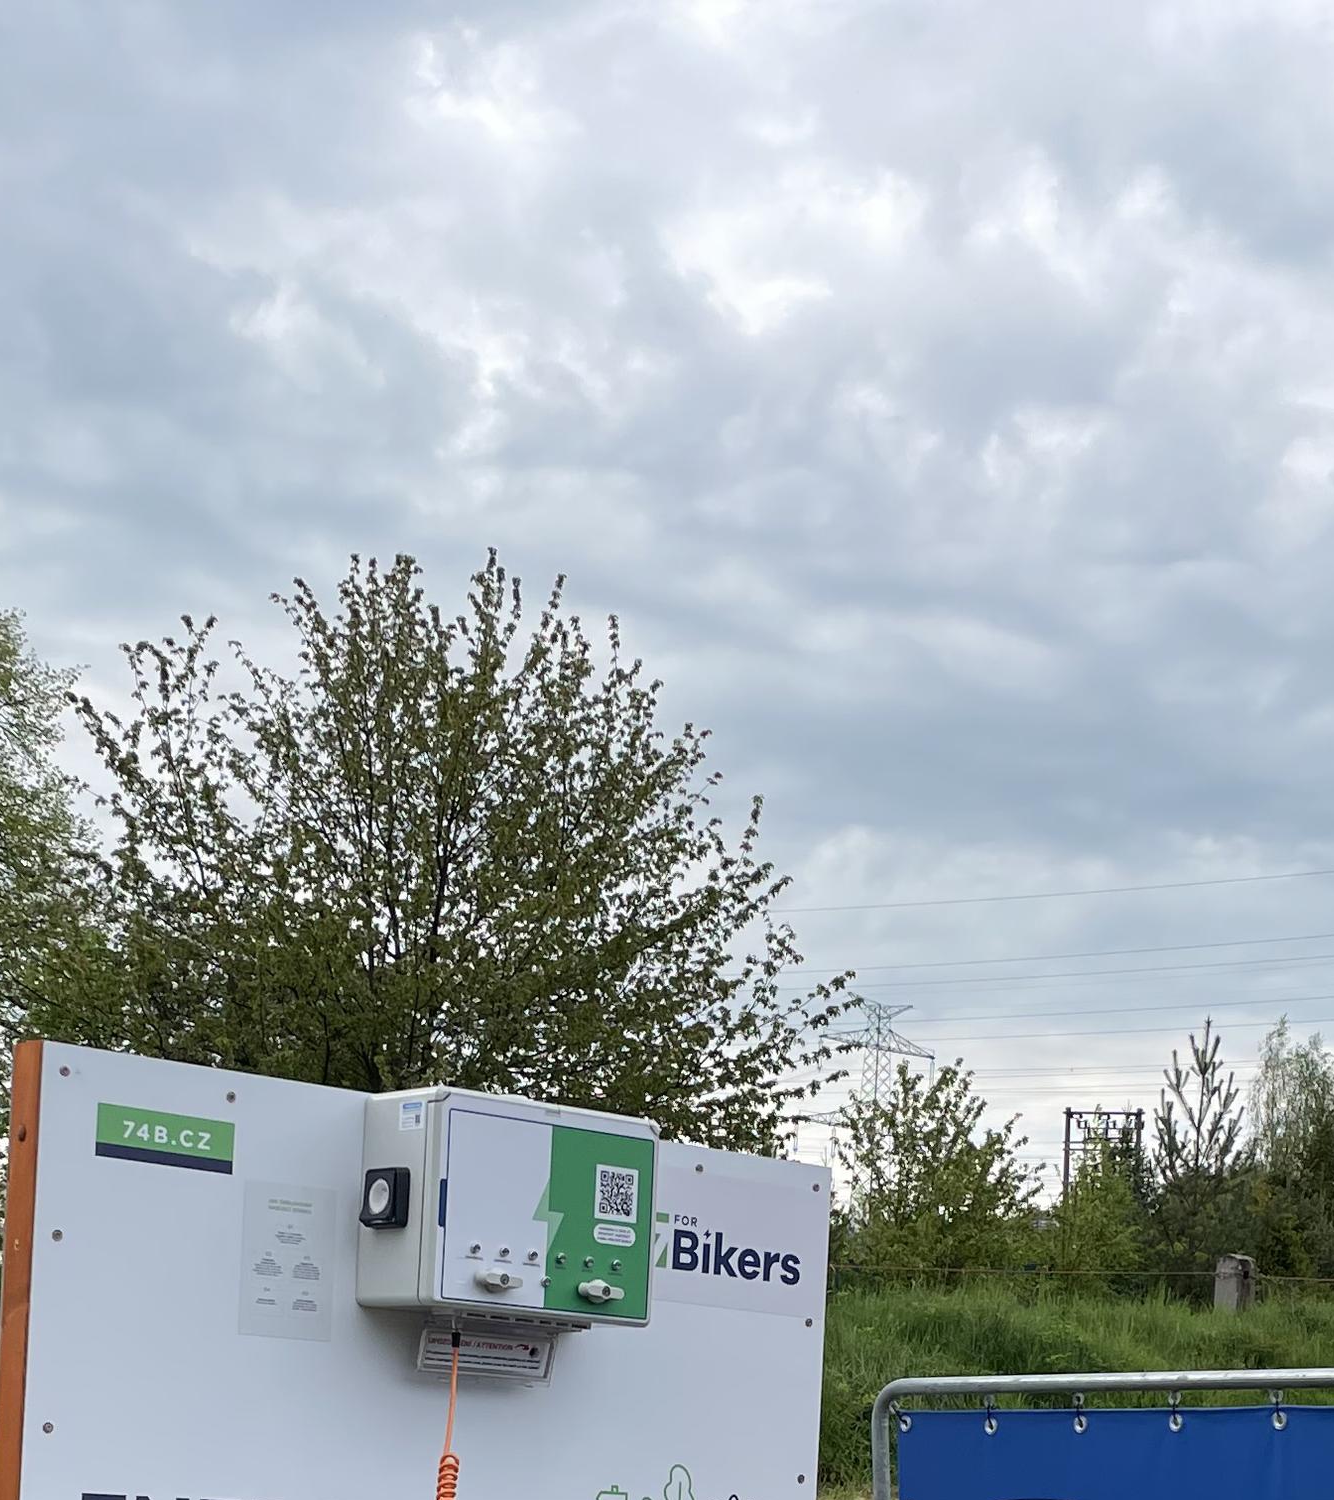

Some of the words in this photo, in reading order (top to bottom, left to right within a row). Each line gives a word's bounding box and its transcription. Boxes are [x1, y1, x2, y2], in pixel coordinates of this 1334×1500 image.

[123, 1120, 211, 1150] 74B.CZ
[674, 1214, 698, 1227] FOR
[672, 1229, 801, 1286] Bikers
